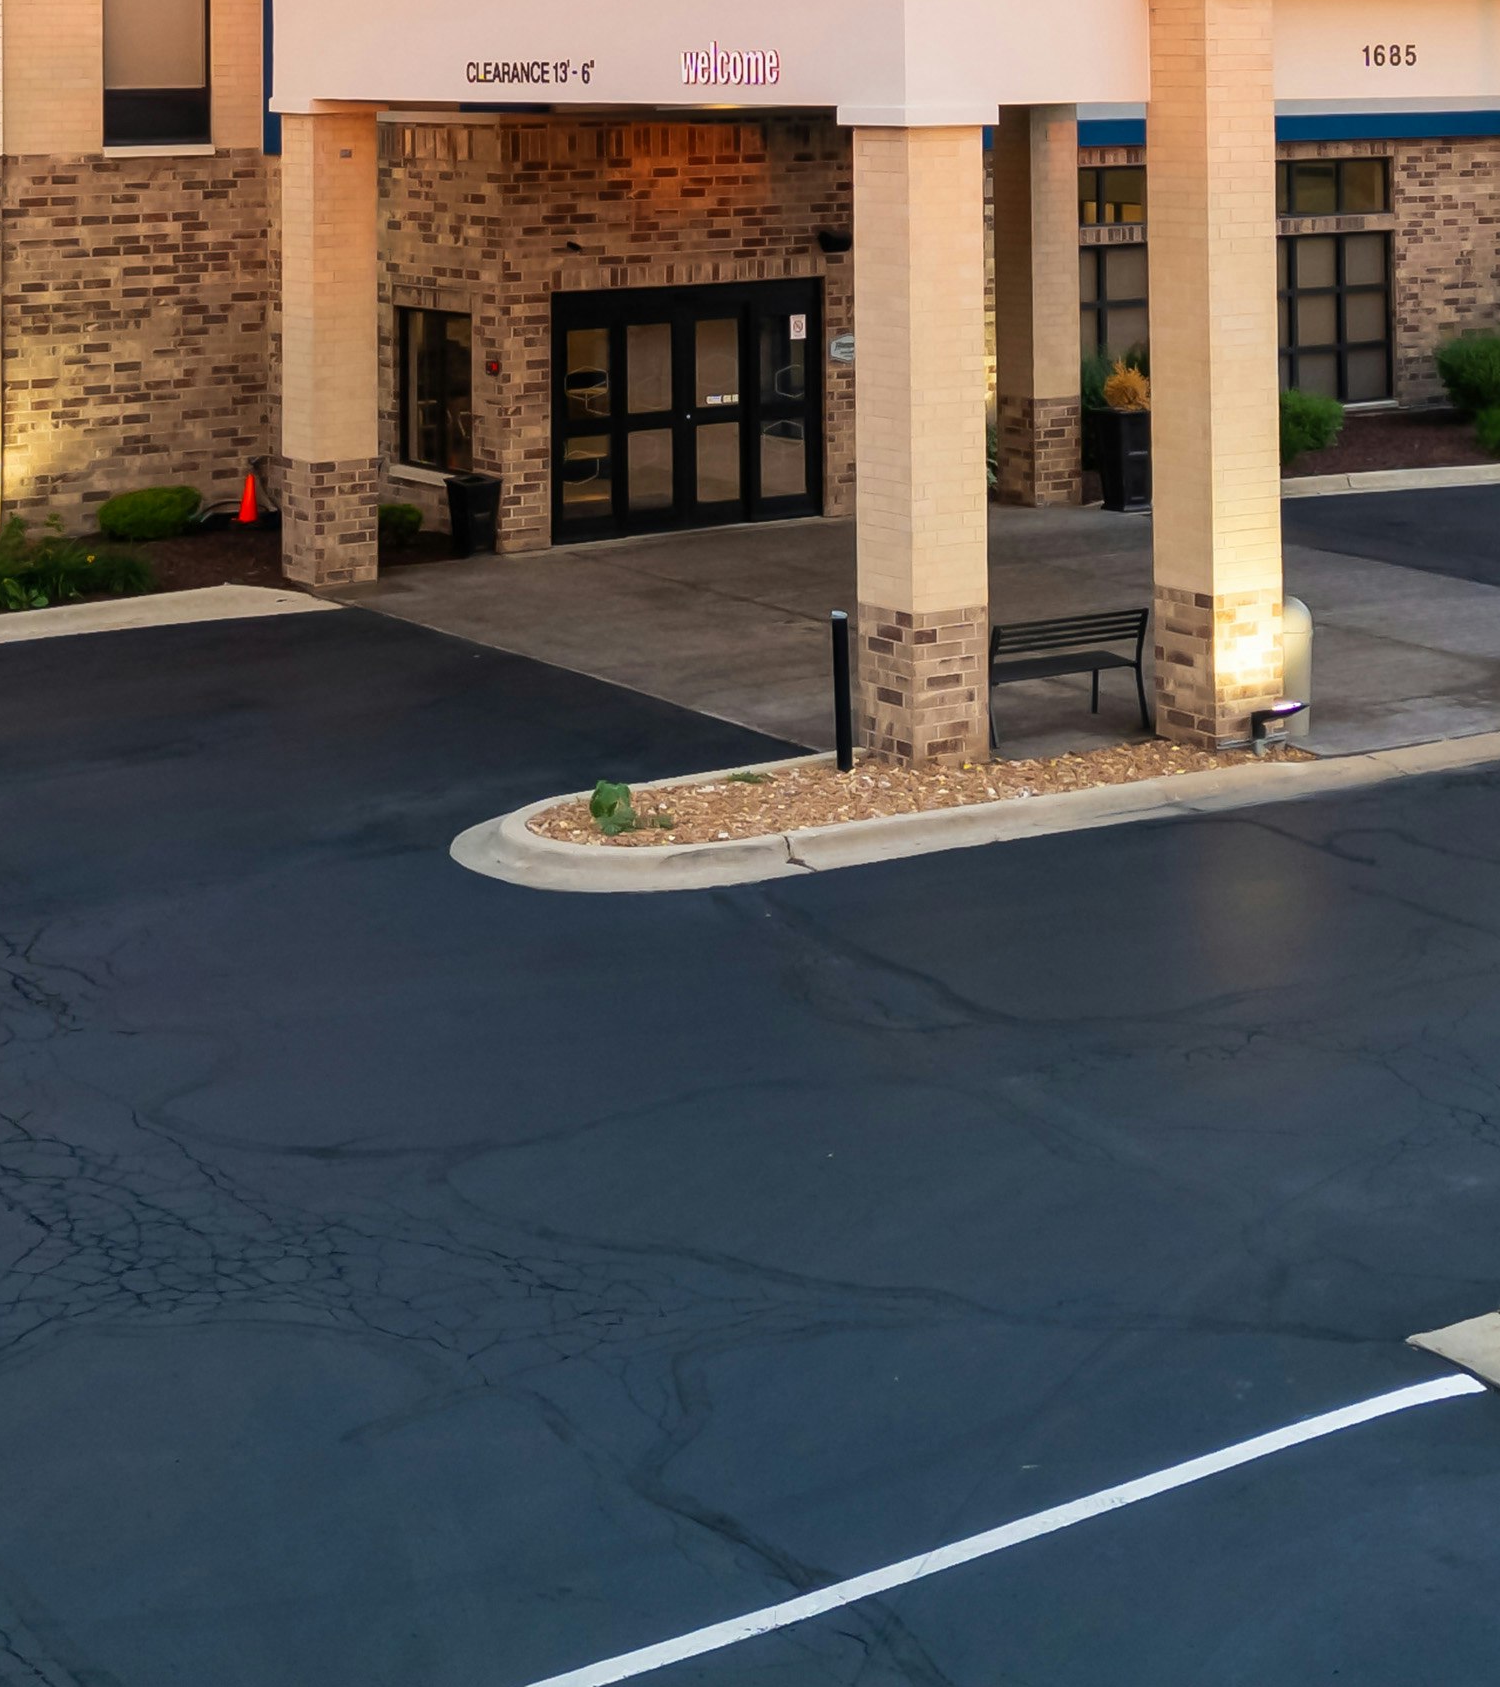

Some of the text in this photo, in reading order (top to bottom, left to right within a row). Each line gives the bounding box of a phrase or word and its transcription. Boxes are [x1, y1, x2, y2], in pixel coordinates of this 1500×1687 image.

[681, 41, 779, 85] welcome
[1362, 44, 1417, 66] 1685
[466, 60, 550, 84] CLEARANCE
